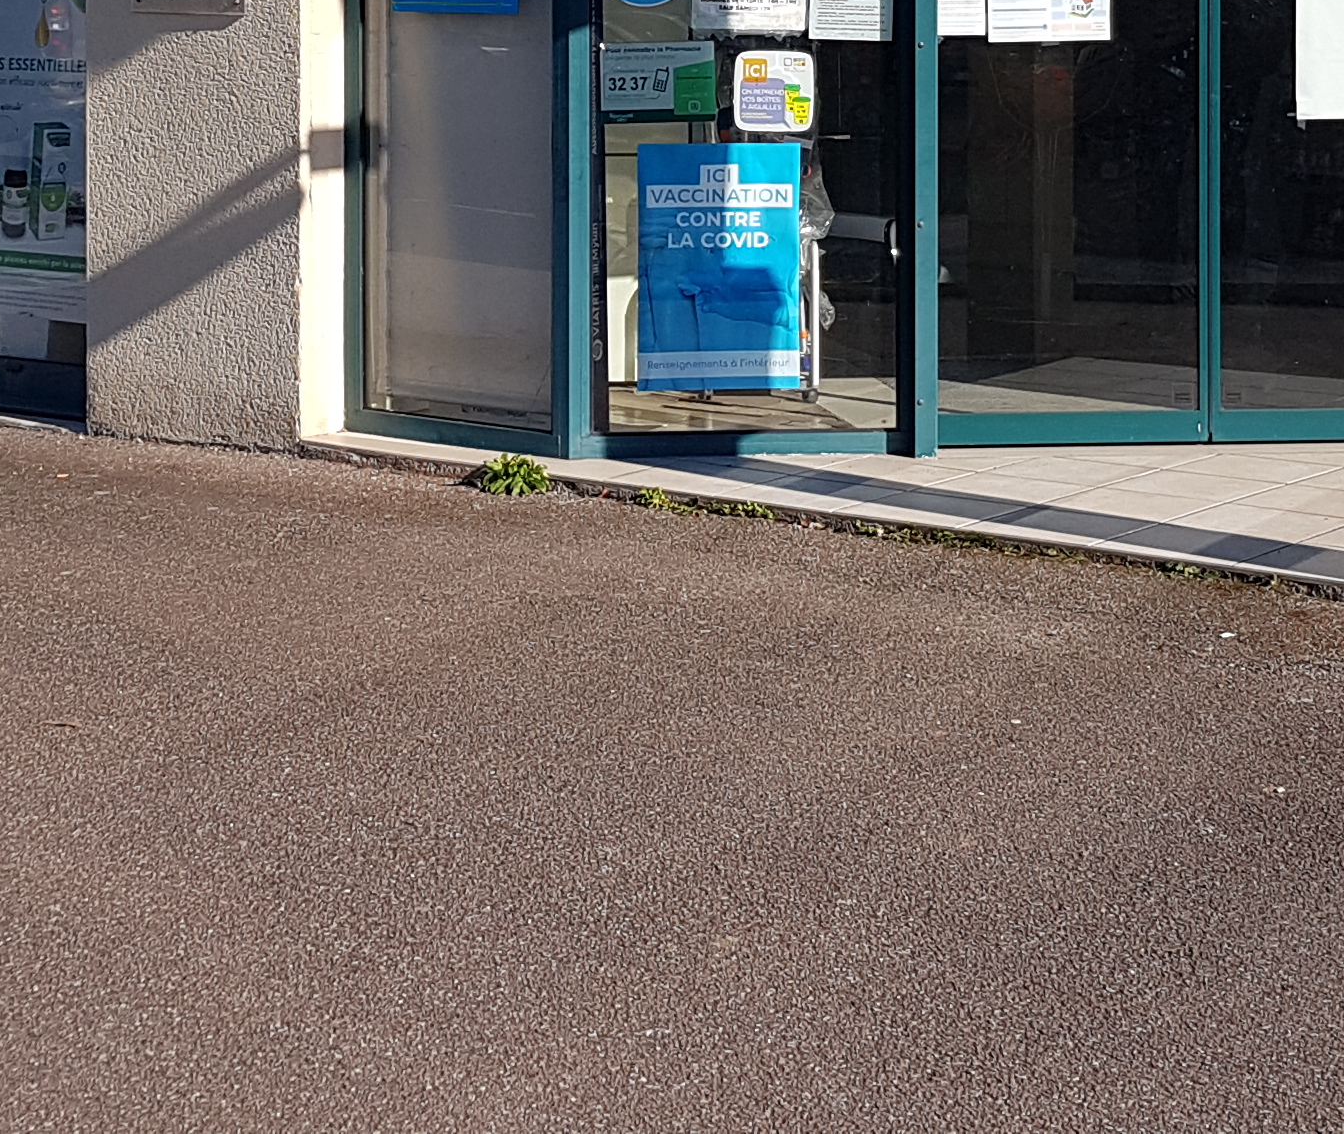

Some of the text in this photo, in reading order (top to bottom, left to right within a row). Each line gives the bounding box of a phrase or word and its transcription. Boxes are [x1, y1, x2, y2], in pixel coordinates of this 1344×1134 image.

[745, 63, 765, 77] ICI
[608, 76, 648, 91] 32 37
[741, 88, 752, 96] ON
[706, 168, 731, 183] ICI
[650, 188, 788, 204] VACCINATION
[675, 211, 762, 227] CONTRE
[667, 232, 770, 249] LA COVID
[647, 357, 790, 370] Renseignements à l'intérieur
